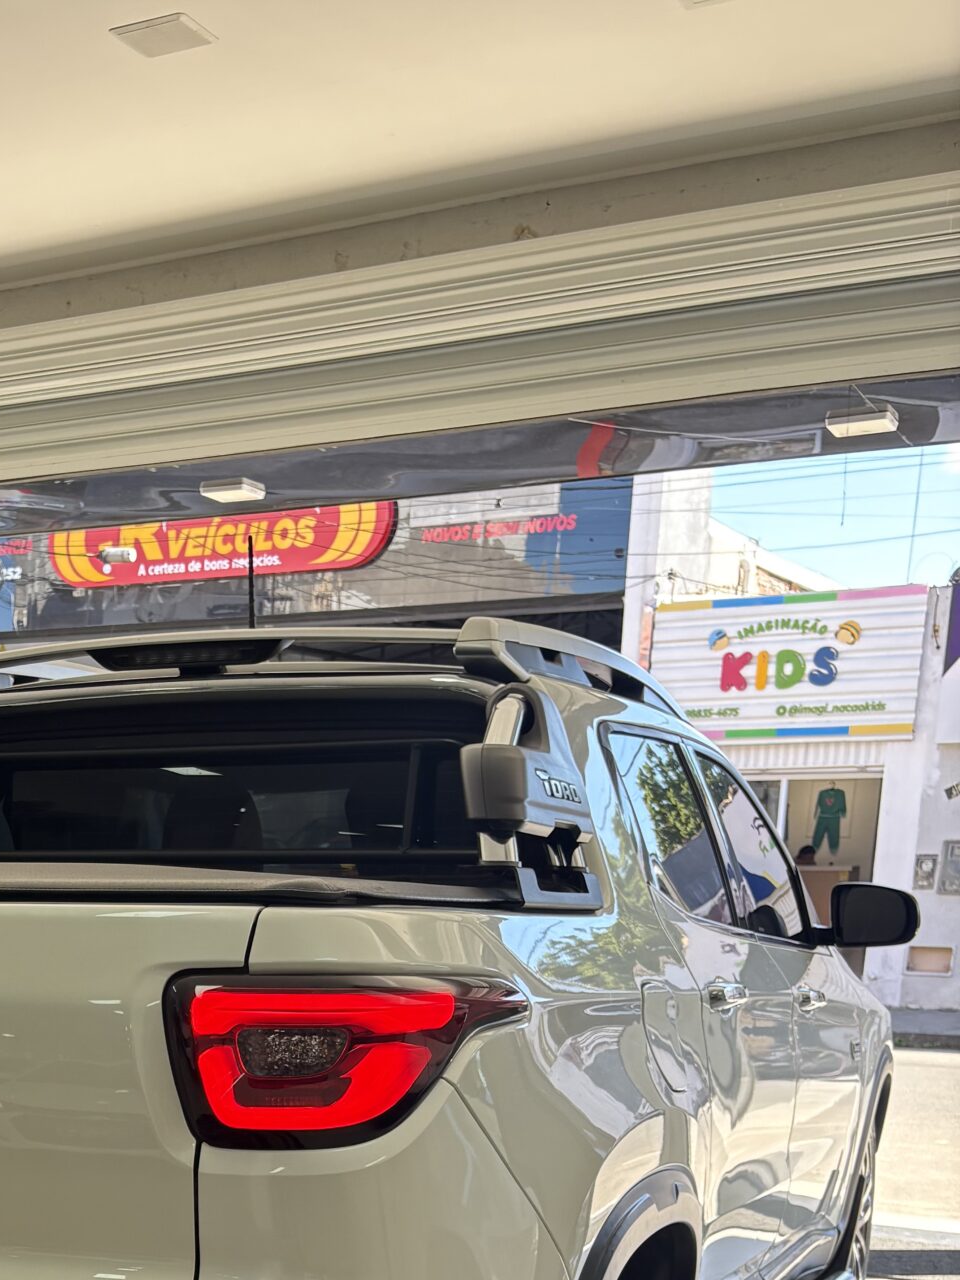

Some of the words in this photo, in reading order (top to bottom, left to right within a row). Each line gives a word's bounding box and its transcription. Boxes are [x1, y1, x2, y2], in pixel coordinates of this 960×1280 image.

[166, 516, 316, 560] VEÍCULOS
[421, 524, 471, 544] NOVOS
[525, 514, 578, 534] NOVOS
[137, 563, 147, 577] A
[148, 562, 186, 576] certeza
[187, 559, 203, 573] de
[204, 556, 230, 571] bons
[737, 618, 829, 641] IMAGINAÇÃO
[720, 646, 839, 692] KIDS
[534, 767, 582, 804] TORO
